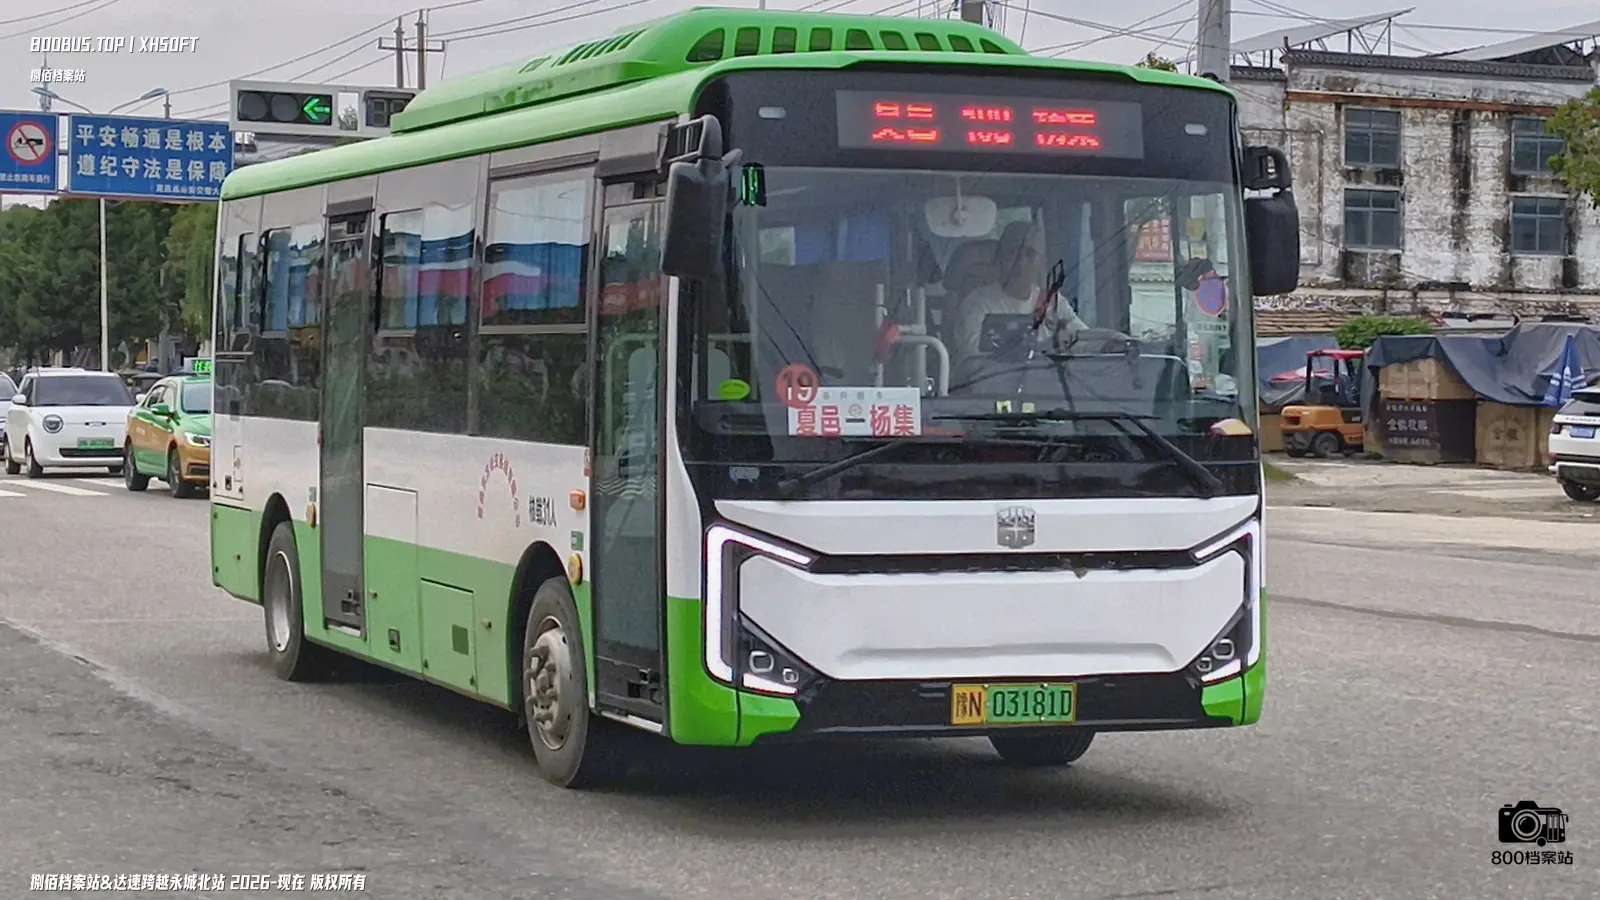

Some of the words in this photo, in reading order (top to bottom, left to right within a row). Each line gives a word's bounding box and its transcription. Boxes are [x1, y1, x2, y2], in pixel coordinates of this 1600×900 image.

[76, 124, 226, 153] 平安畅通是根本
[782, 371, 813, 402] 19
[993, 690, 1073, 717] 03181D
